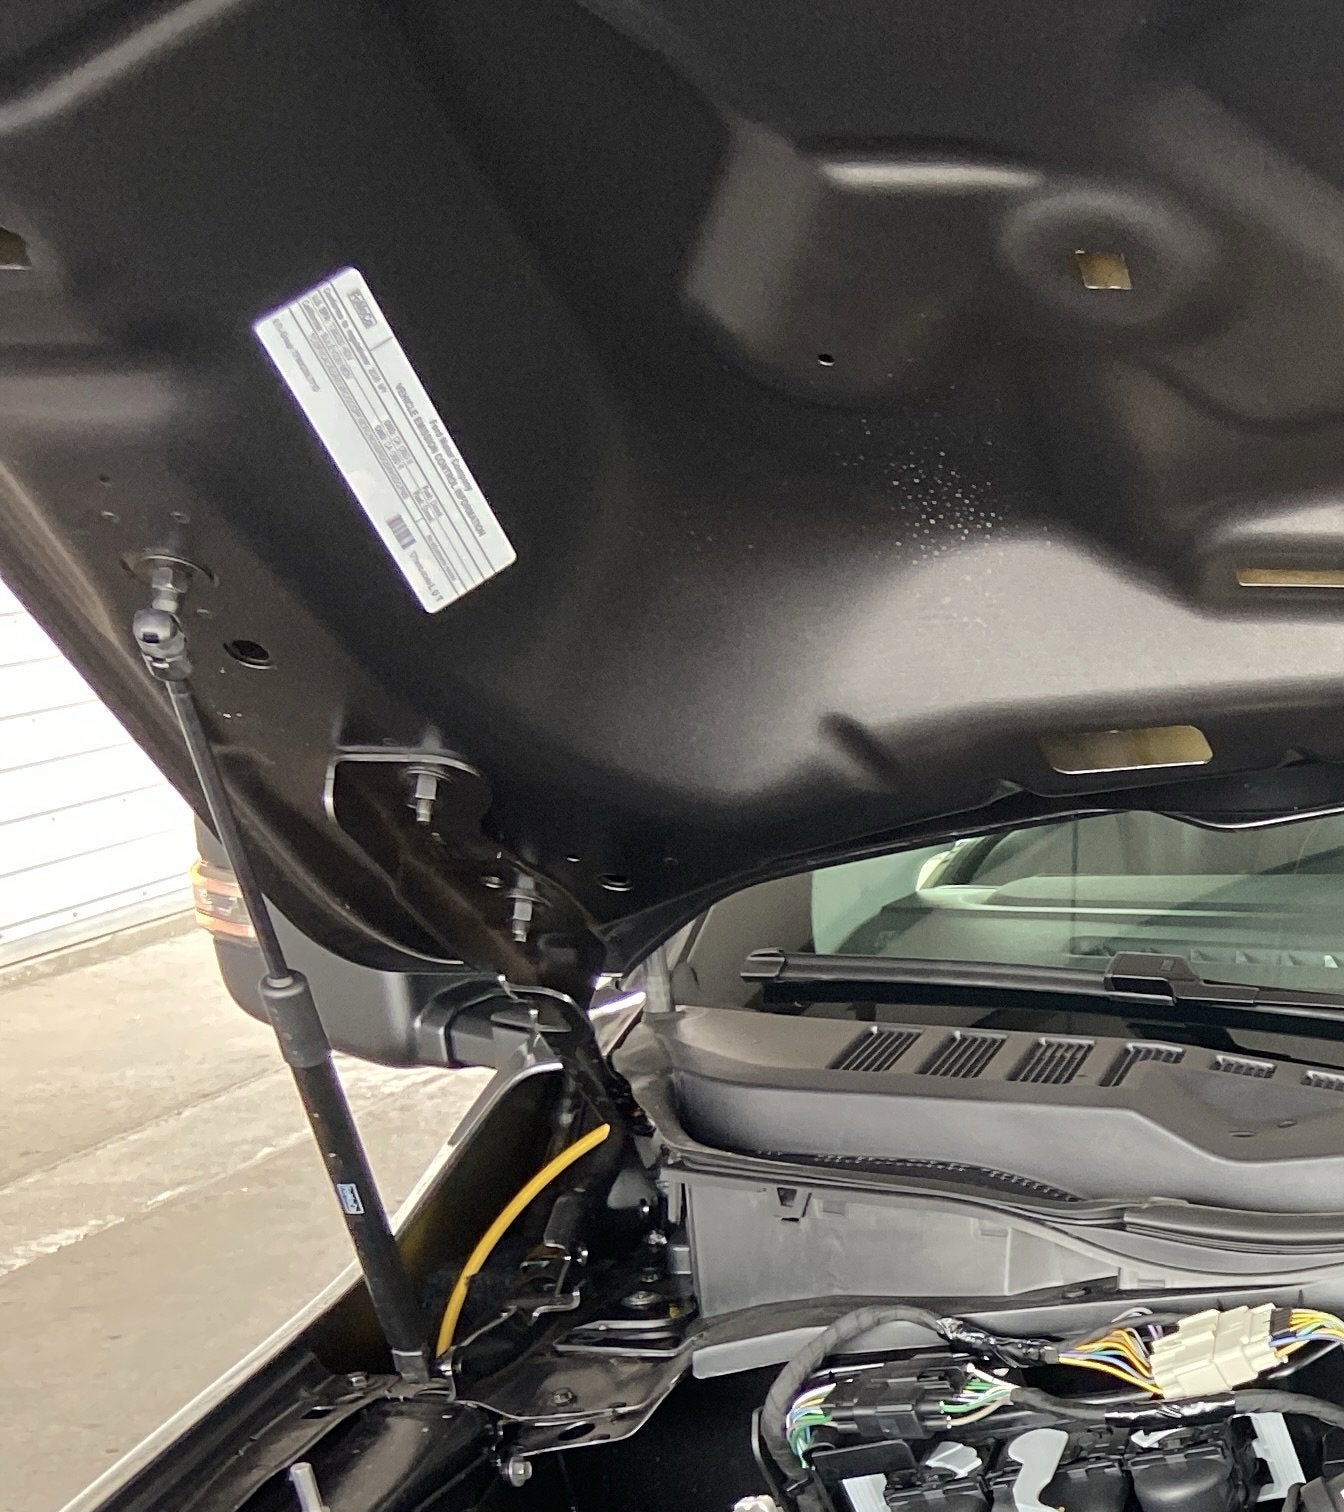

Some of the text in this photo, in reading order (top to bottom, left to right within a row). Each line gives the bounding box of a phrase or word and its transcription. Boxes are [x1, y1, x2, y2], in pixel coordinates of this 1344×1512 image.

[394, 382, 418, 417] VEHICLE
[413, 416, 439, 453] EMISSION
[433, 452, 459, 489] CONTROL
